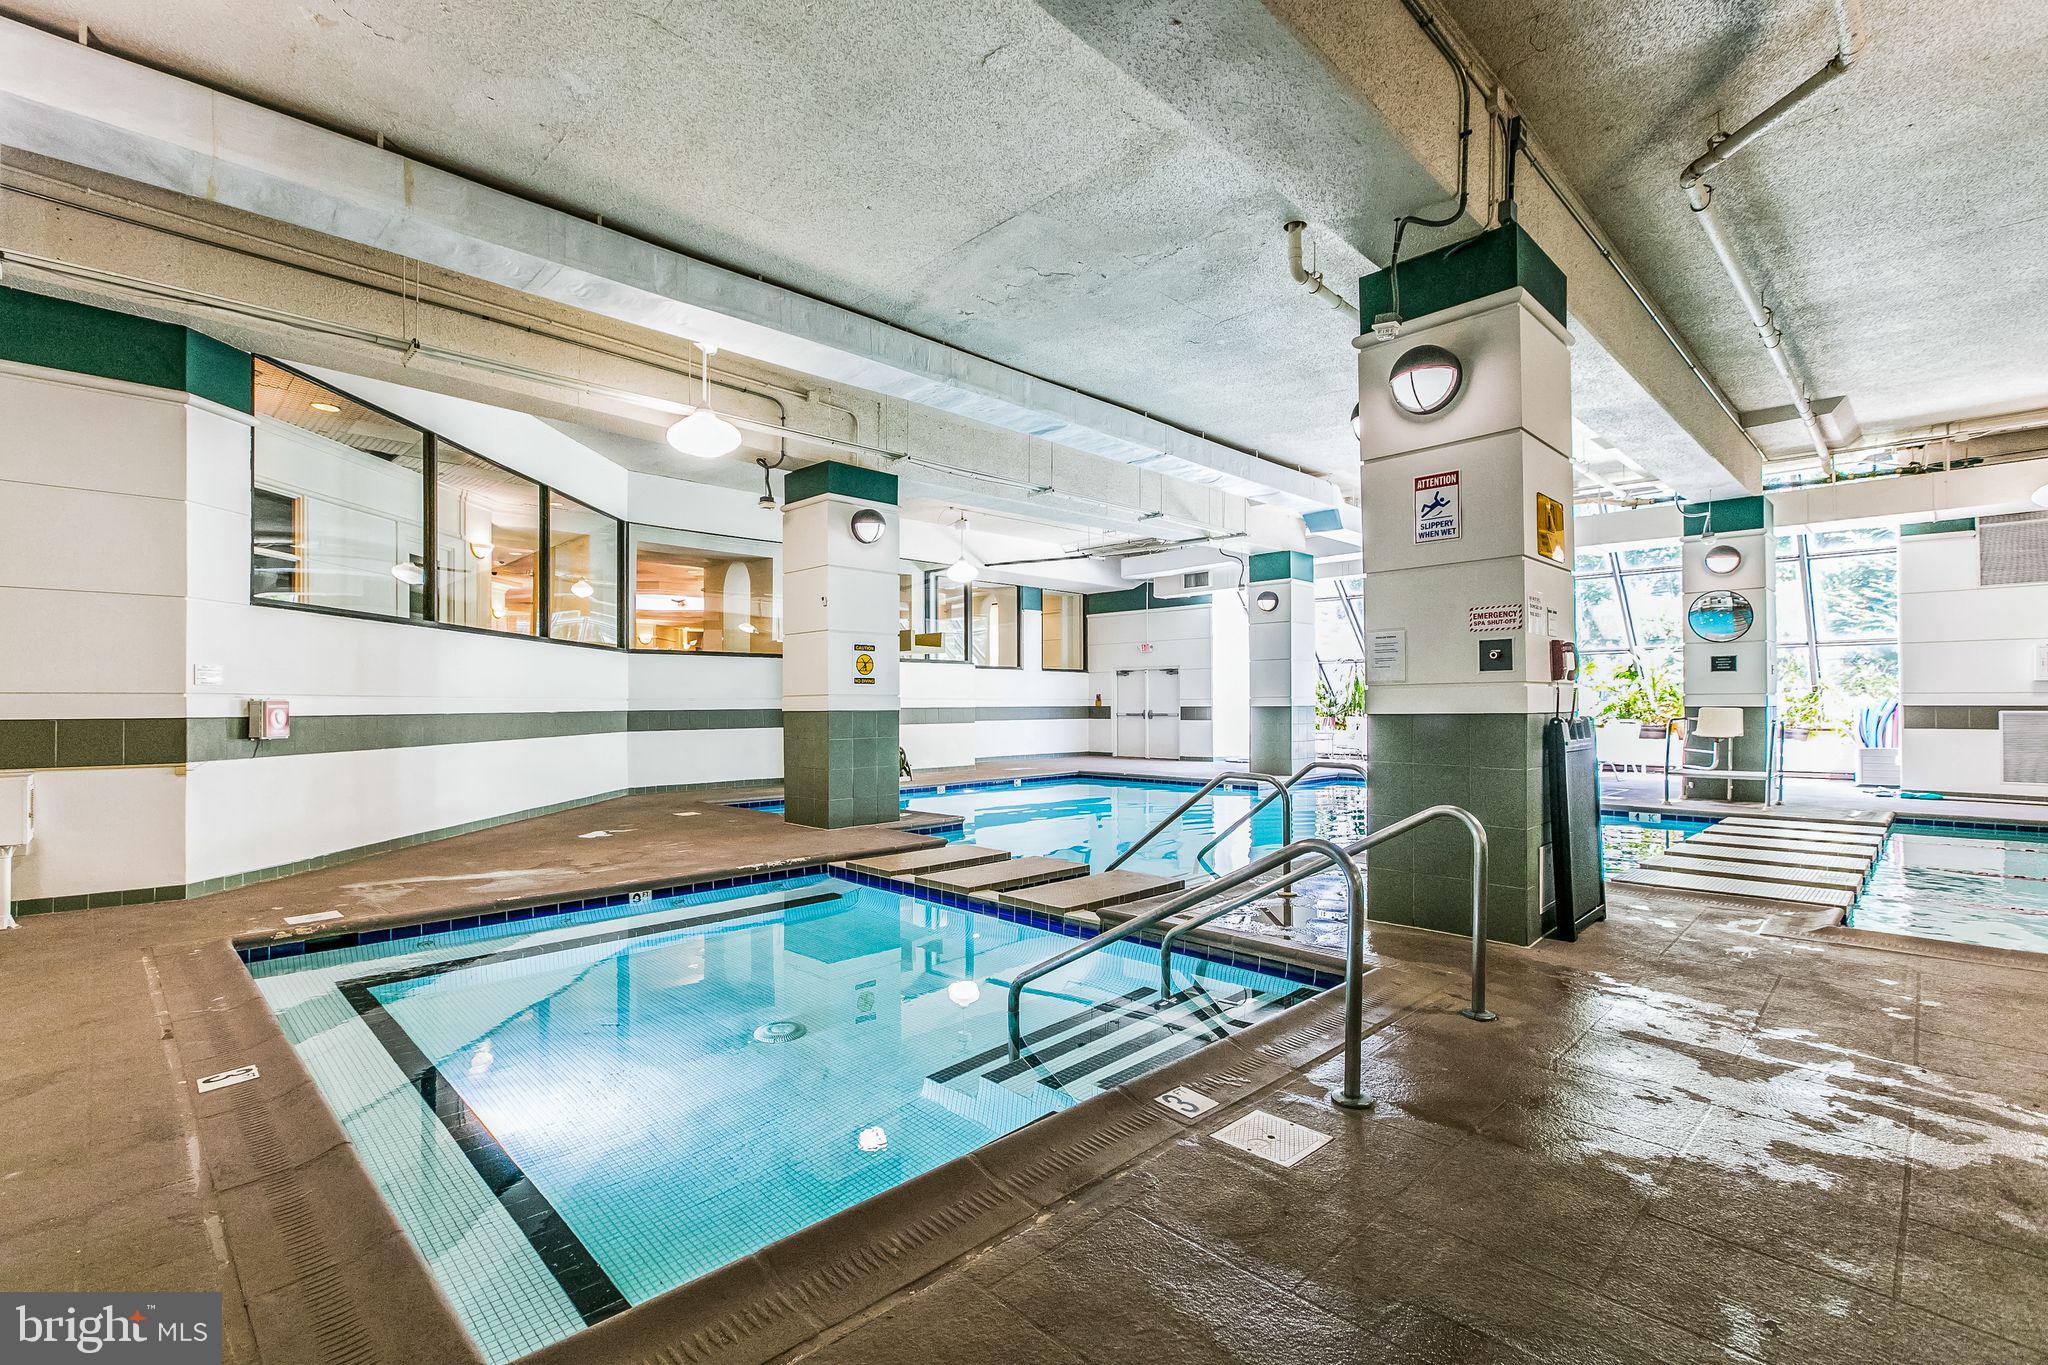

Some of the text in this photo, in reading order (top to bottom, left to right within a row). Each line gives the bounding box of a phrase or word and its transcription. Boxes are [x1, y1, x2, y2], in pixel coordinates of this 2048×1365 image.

[1417, 474, 1457, 489] ATTENTION
[1420, 519, 1454, 531] SLIPPERY
[1418, 528, 1457, 539] WHEN WET
[1473, 610, 1518, 620] EMERGENCY
[1487, 618, 1517, 626] SHUT-OFF
[1161, 1094, 1201, 1113] 3
